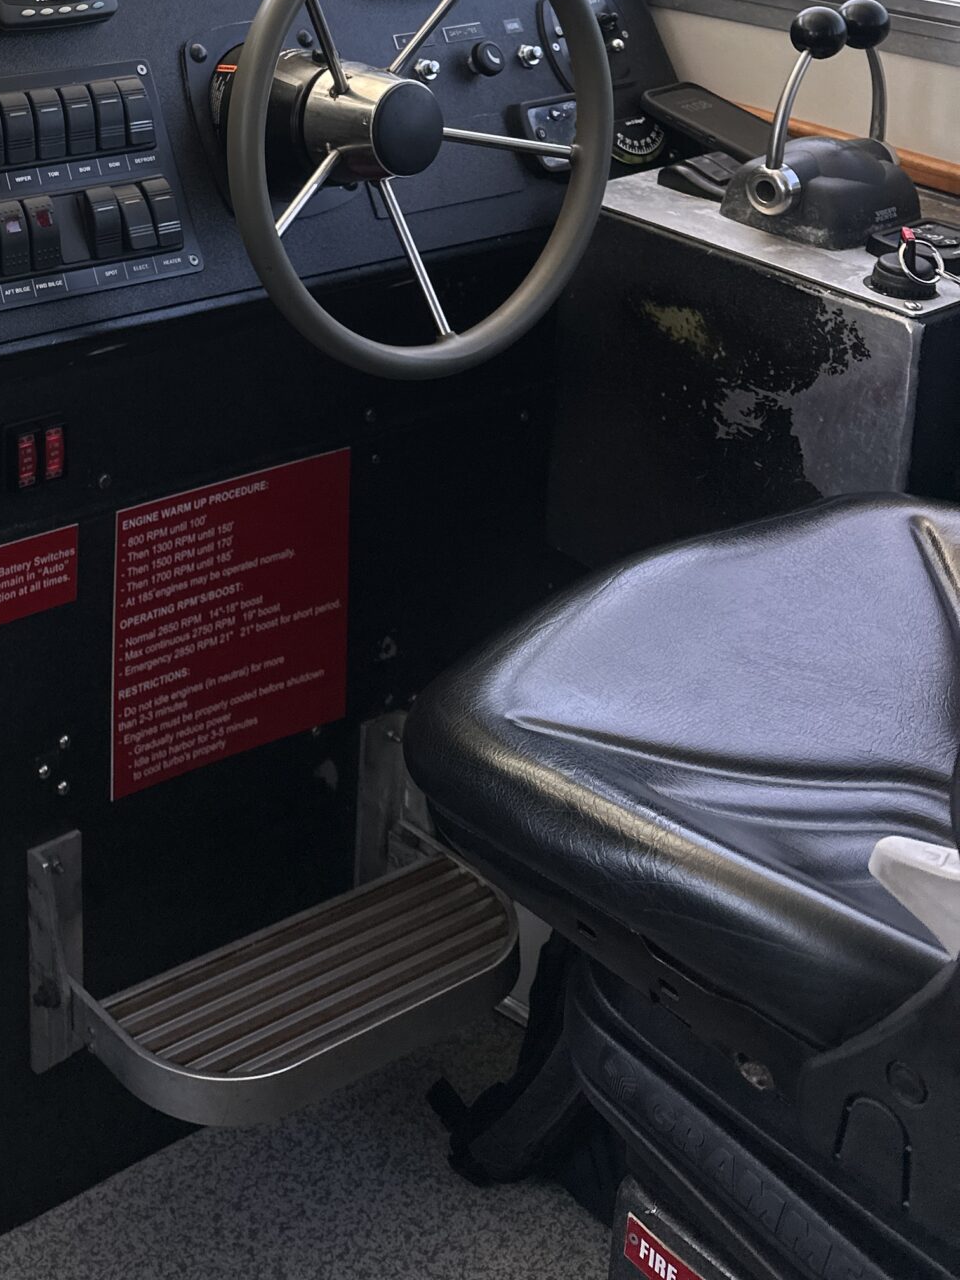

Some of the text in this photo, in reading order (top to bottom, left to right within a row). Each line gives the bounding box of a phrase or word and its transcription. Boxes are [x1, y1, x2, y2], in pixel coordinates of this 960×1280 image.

[134, 155, 156, 164] DEFROST
[15, 175, 32, 183] WIPER
[105, 269, 118, 277] SPOT
[163, 257, 182, 266] HEATER
[5, 285, 31, 296] AFT BILGE
[35, 279, 63, 290] FWD BILGE
[122, 480, 270, 531] ENGINE WARM UP PROCEDURE:
[127, 533, 145, 548] 800
[146, 528, 169, 543] RPM
[169, 520, 188, 536] until
[127, 548, 150, 563] Then
[152, 541, 173, 556] 1300
[174, 534, 196, 550] RPM
[197, 527, 216, 542] until
[33, 548, 76, 566] Switches
[126, 578, 149, 593] Then
[151, 571, 172, 585] 1700
[173, 563, 195, 579] RPM
[196, 556, 214, 571] until
[127, 563, 150, 578] Then
[152, 556, 173, 570] 1500
[174, 549, 196, 565] RPM
[197, 541, 215, 557] until
[18, 586, 28, 597] at
[29, 580, 41, 593] all
[43, 574, 70, 589] times.
[26, 571, 35, 582] in
[125, 594, 136, 608] At
[190, 572, 208, 588] may
[209, 567, 221, 581] be
[222, 557, 259, 579] operated
[259, 547, 296, 566] normally.
[119, 582, 244, 631] OPERATING RPM'S/BOOST:
[125, 629, 157, 648] Normal
[180, 613, 202, 631] RPM
[240, 594, 264, 610] boost
[125, 648, 144, 663] Max
[144, 631, 190, 654] continuous
[214, 615, 236, 632] RPM
[257, 602, 281, 618] boost
[125, 654, 173, 678] Emergency
[196, 635, 219, 652] RPM
[255, 618, 280, 634] boost
[279, 613, 291, 627] for
[292, 606, 314, 622] short
[314, 598, 342, 617] period.
[118, 666, 191, 701] RESTRICTIONS:
[124, 655, 285, 718] Do not idle engines (in neutral) for more
[118, 718, 138, 733] than
[154, 699, 189, 719] minutes
[123, 668, 325, 745] Engines must be properly cooled before shutdown
[133, 753, 151, 768] Idle
[151, 747, 168, 761] into
[168, 738, 196, 757] harbor
[197, 733, 210, 746] for
[226, 716, 259, 734] minutes
[134, 712, 232, 755] Gradually reduce power
[133, 739, 227, 781] to cool turbo's properly
[639, 1238, 678, 1280] FIRE
